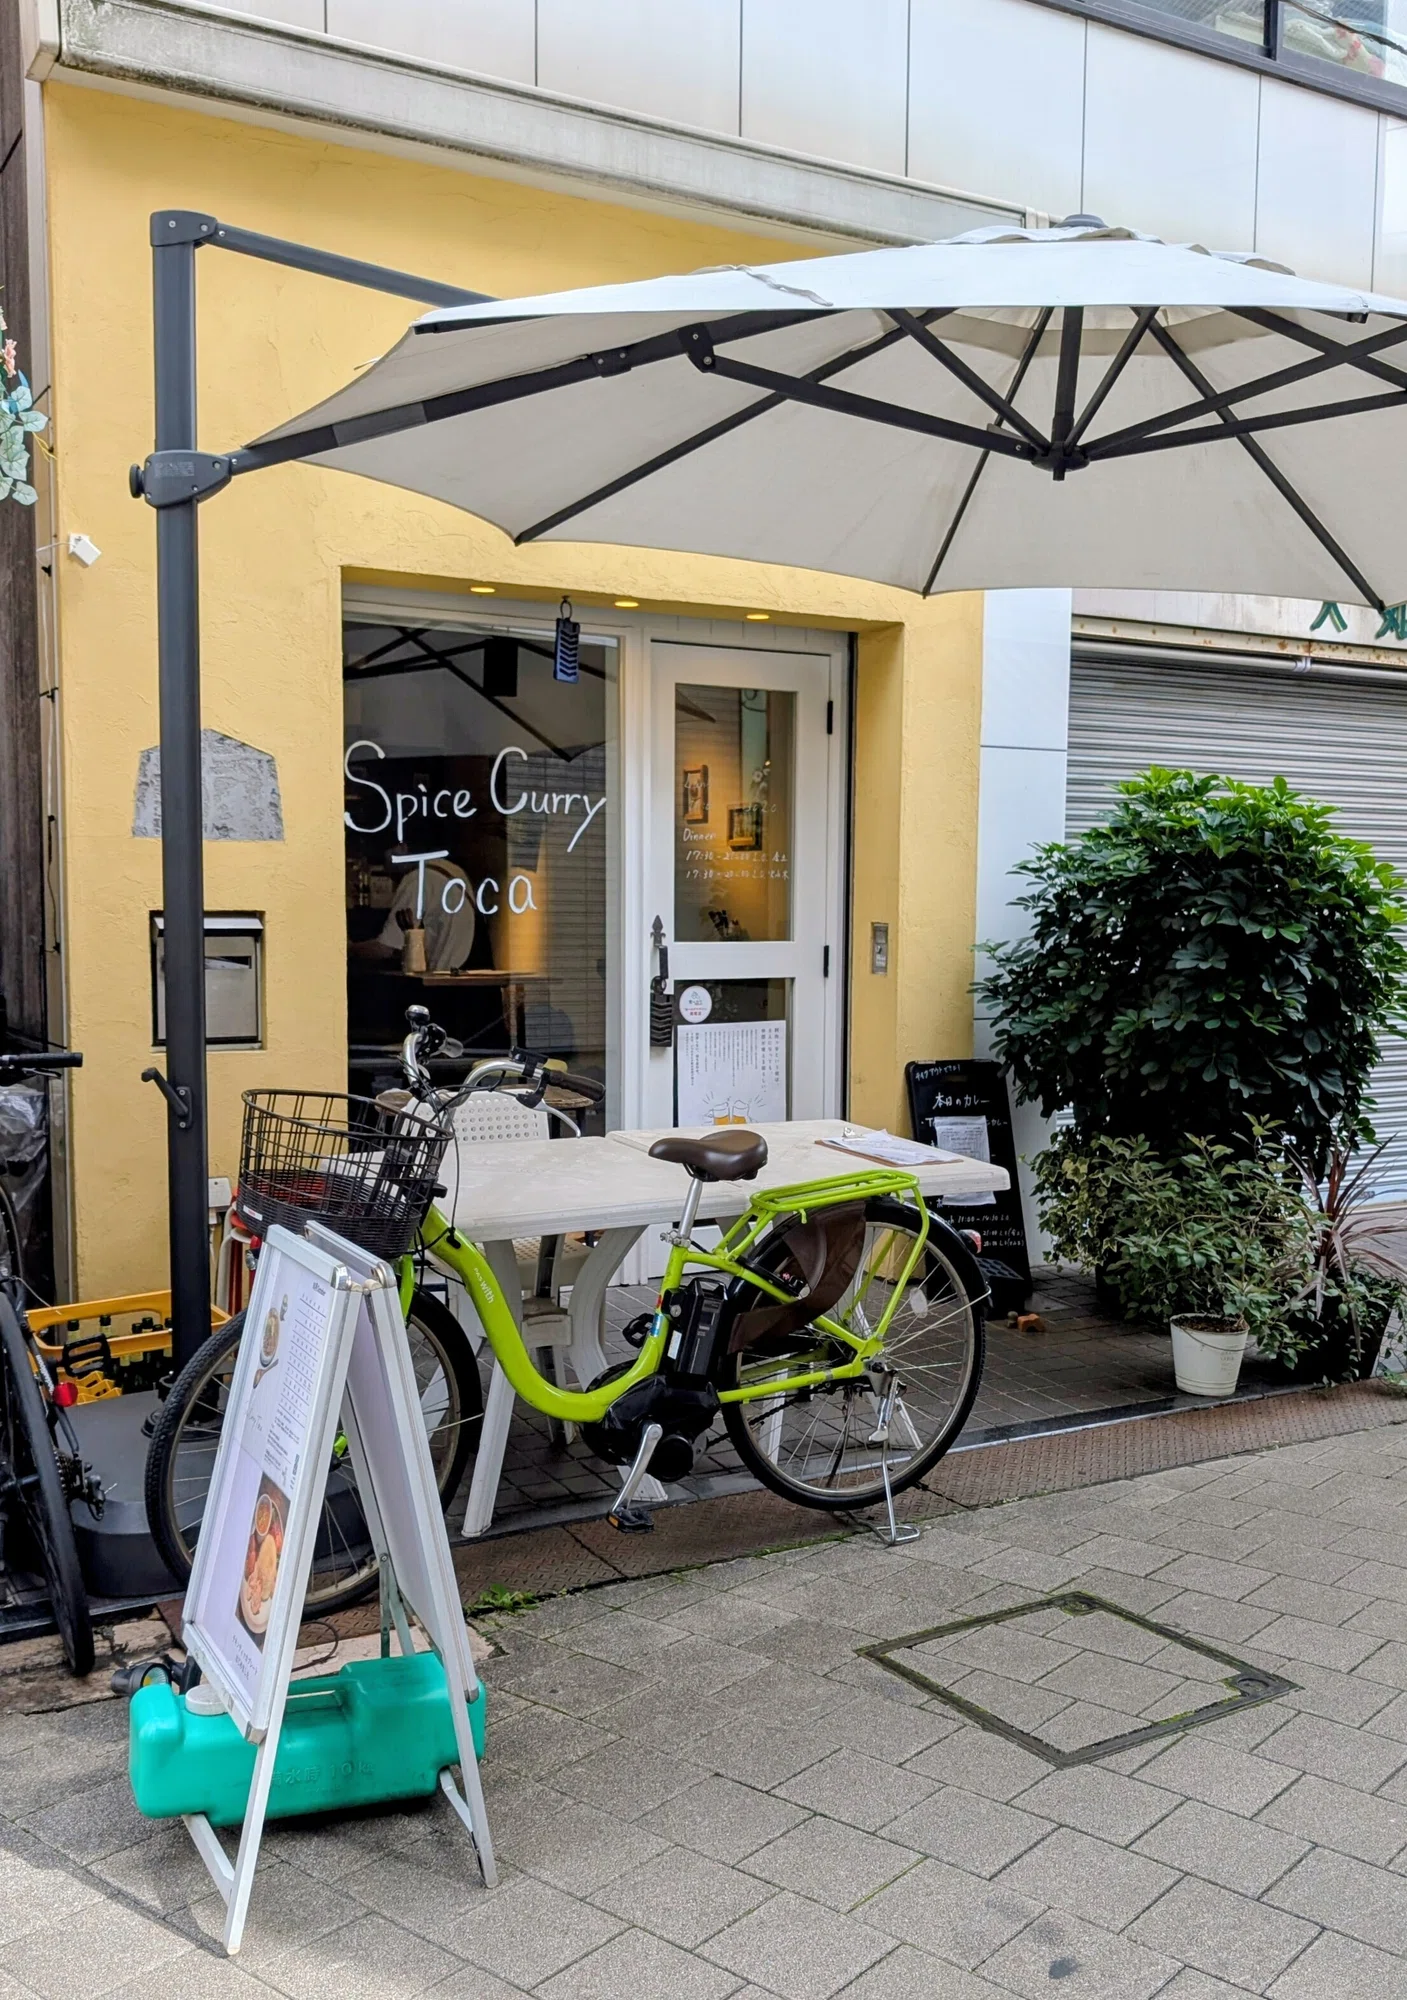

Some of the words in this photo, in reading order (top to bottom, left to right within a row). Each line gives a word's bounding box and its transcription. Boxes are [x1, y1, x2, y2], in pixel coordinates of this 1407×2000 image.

[344, 740, 477, 843] Spice
[490, 746, 607, 853] Curry
[391, 850, 538, 920] Toca
[932, 1092, 990, 1110] 本日のカレー
